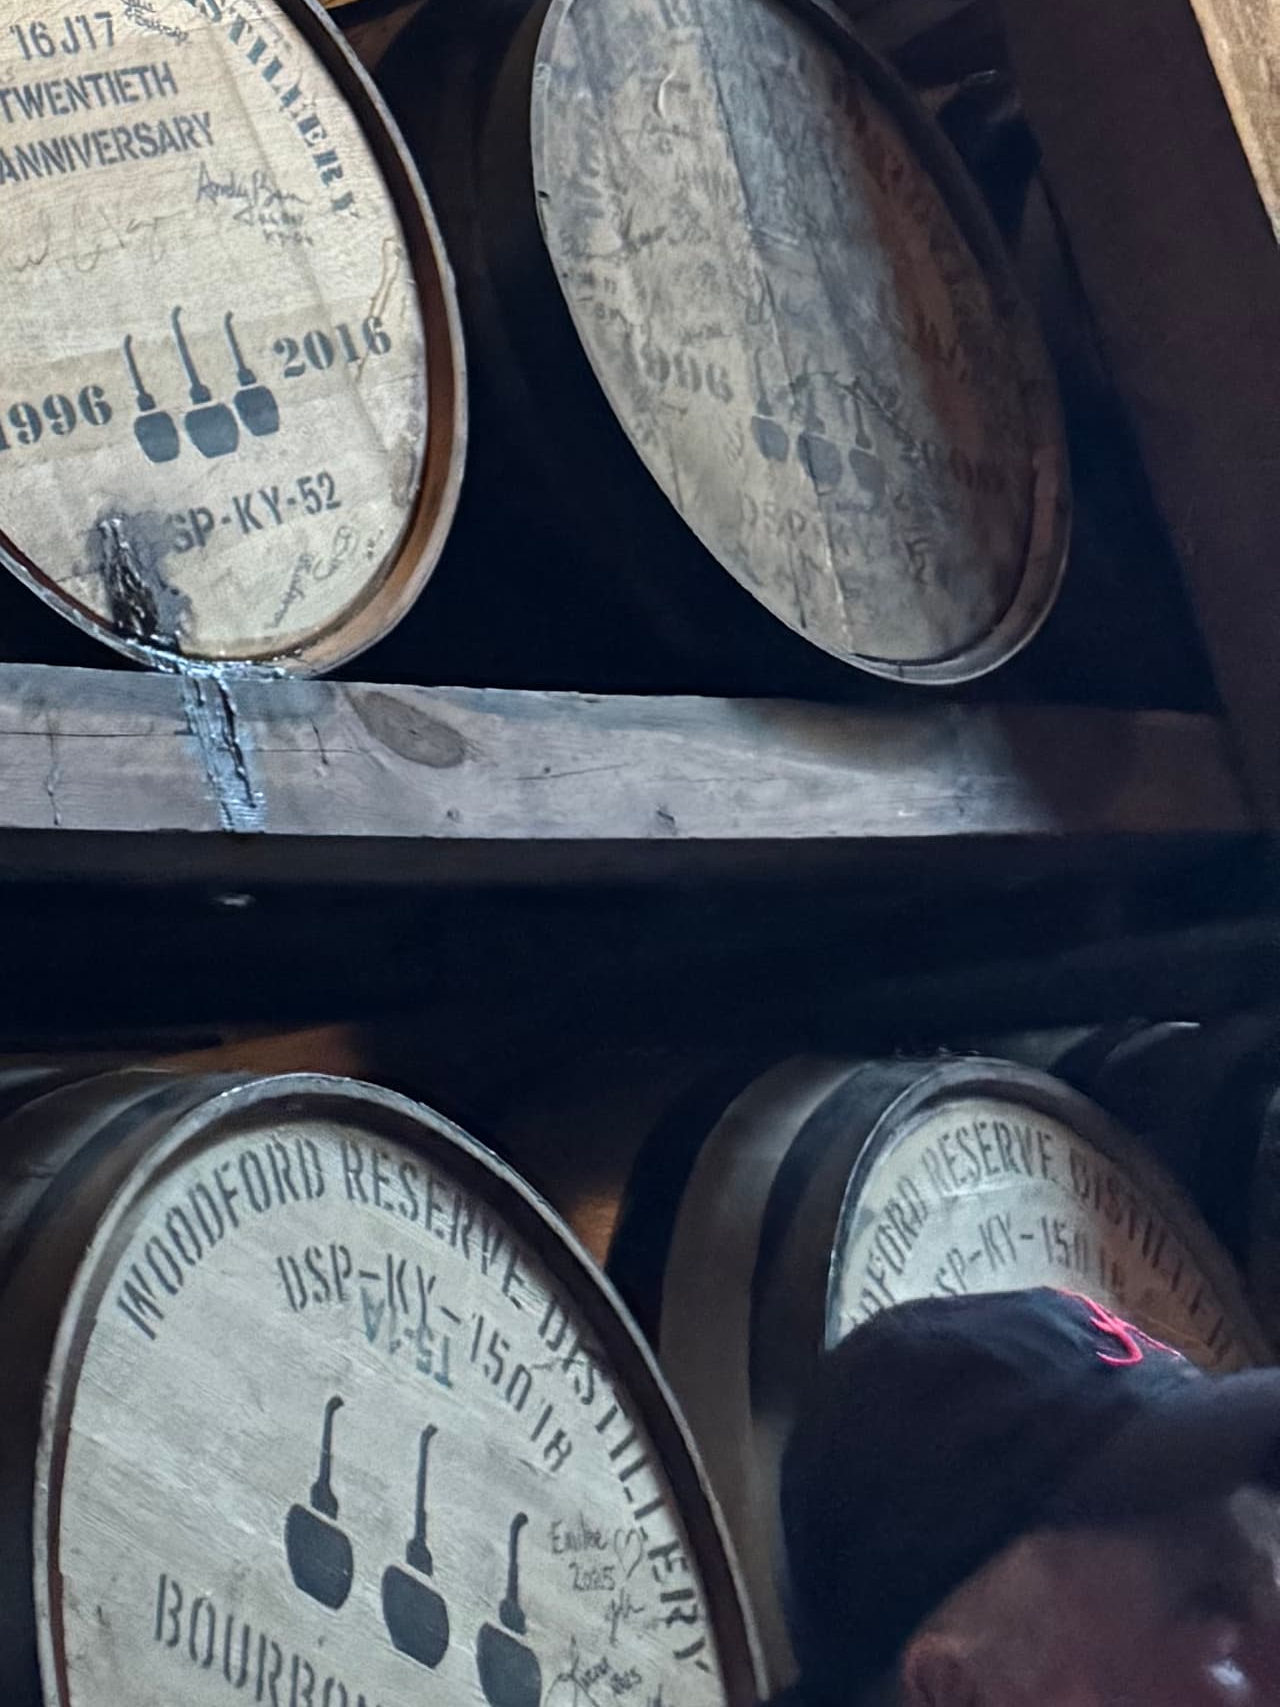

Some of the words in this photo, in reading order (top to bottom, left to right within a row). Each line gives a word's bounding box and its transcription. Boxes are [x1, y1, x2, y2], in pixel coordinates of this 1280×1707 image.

[273, 316, 393, 379] 2016
[164, 472, 342, 554] SP-KY-52
[922, 1120, 1058, 1195] RESERVE
[116, 1138, 326, 1341] WOODFORD
[340, 1139, 525, 1310] RESERVE
[537, 1295, 711, 1673] DISTILLERY
[276, 1244, 573, 1473] DSP-KY-15018
[154, 1573, 383, 1707] BOURBO
